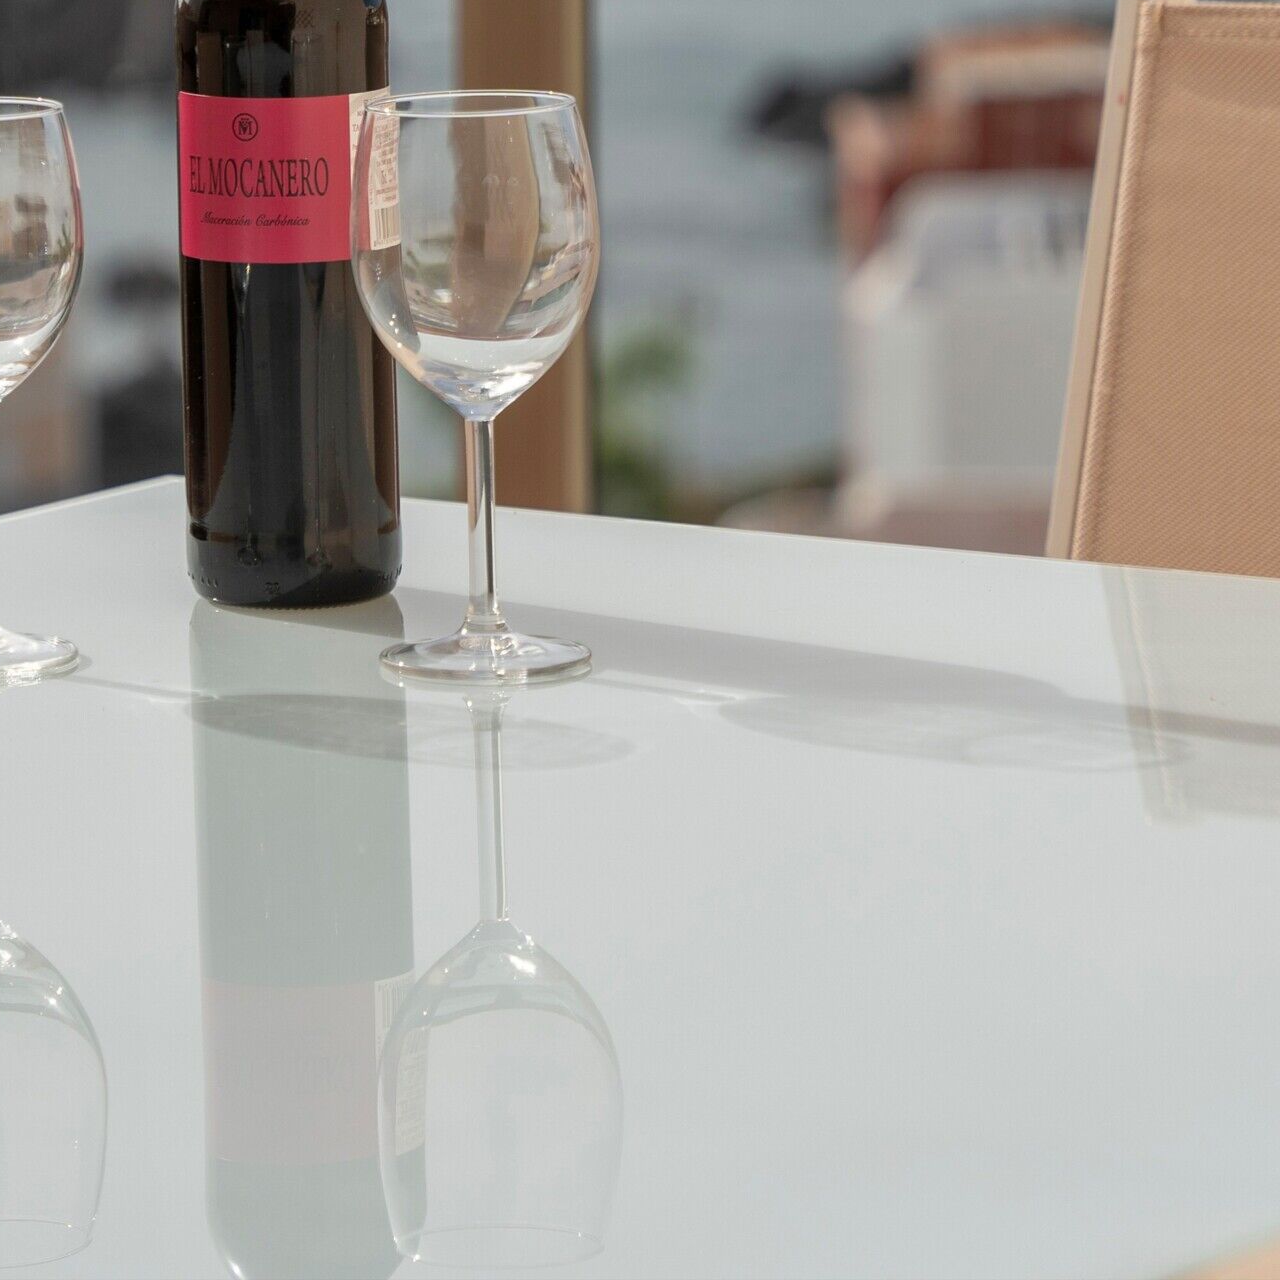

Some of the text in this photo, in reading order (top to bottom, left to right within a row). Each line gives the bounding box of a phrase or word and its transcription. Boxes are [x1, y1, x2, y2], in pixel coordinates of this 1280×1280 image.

[189, 155, 205, 195] EL
[208, 157, 329, 198] MOCANERO
[200, 211, 310, 227] Maceración Carbónica
